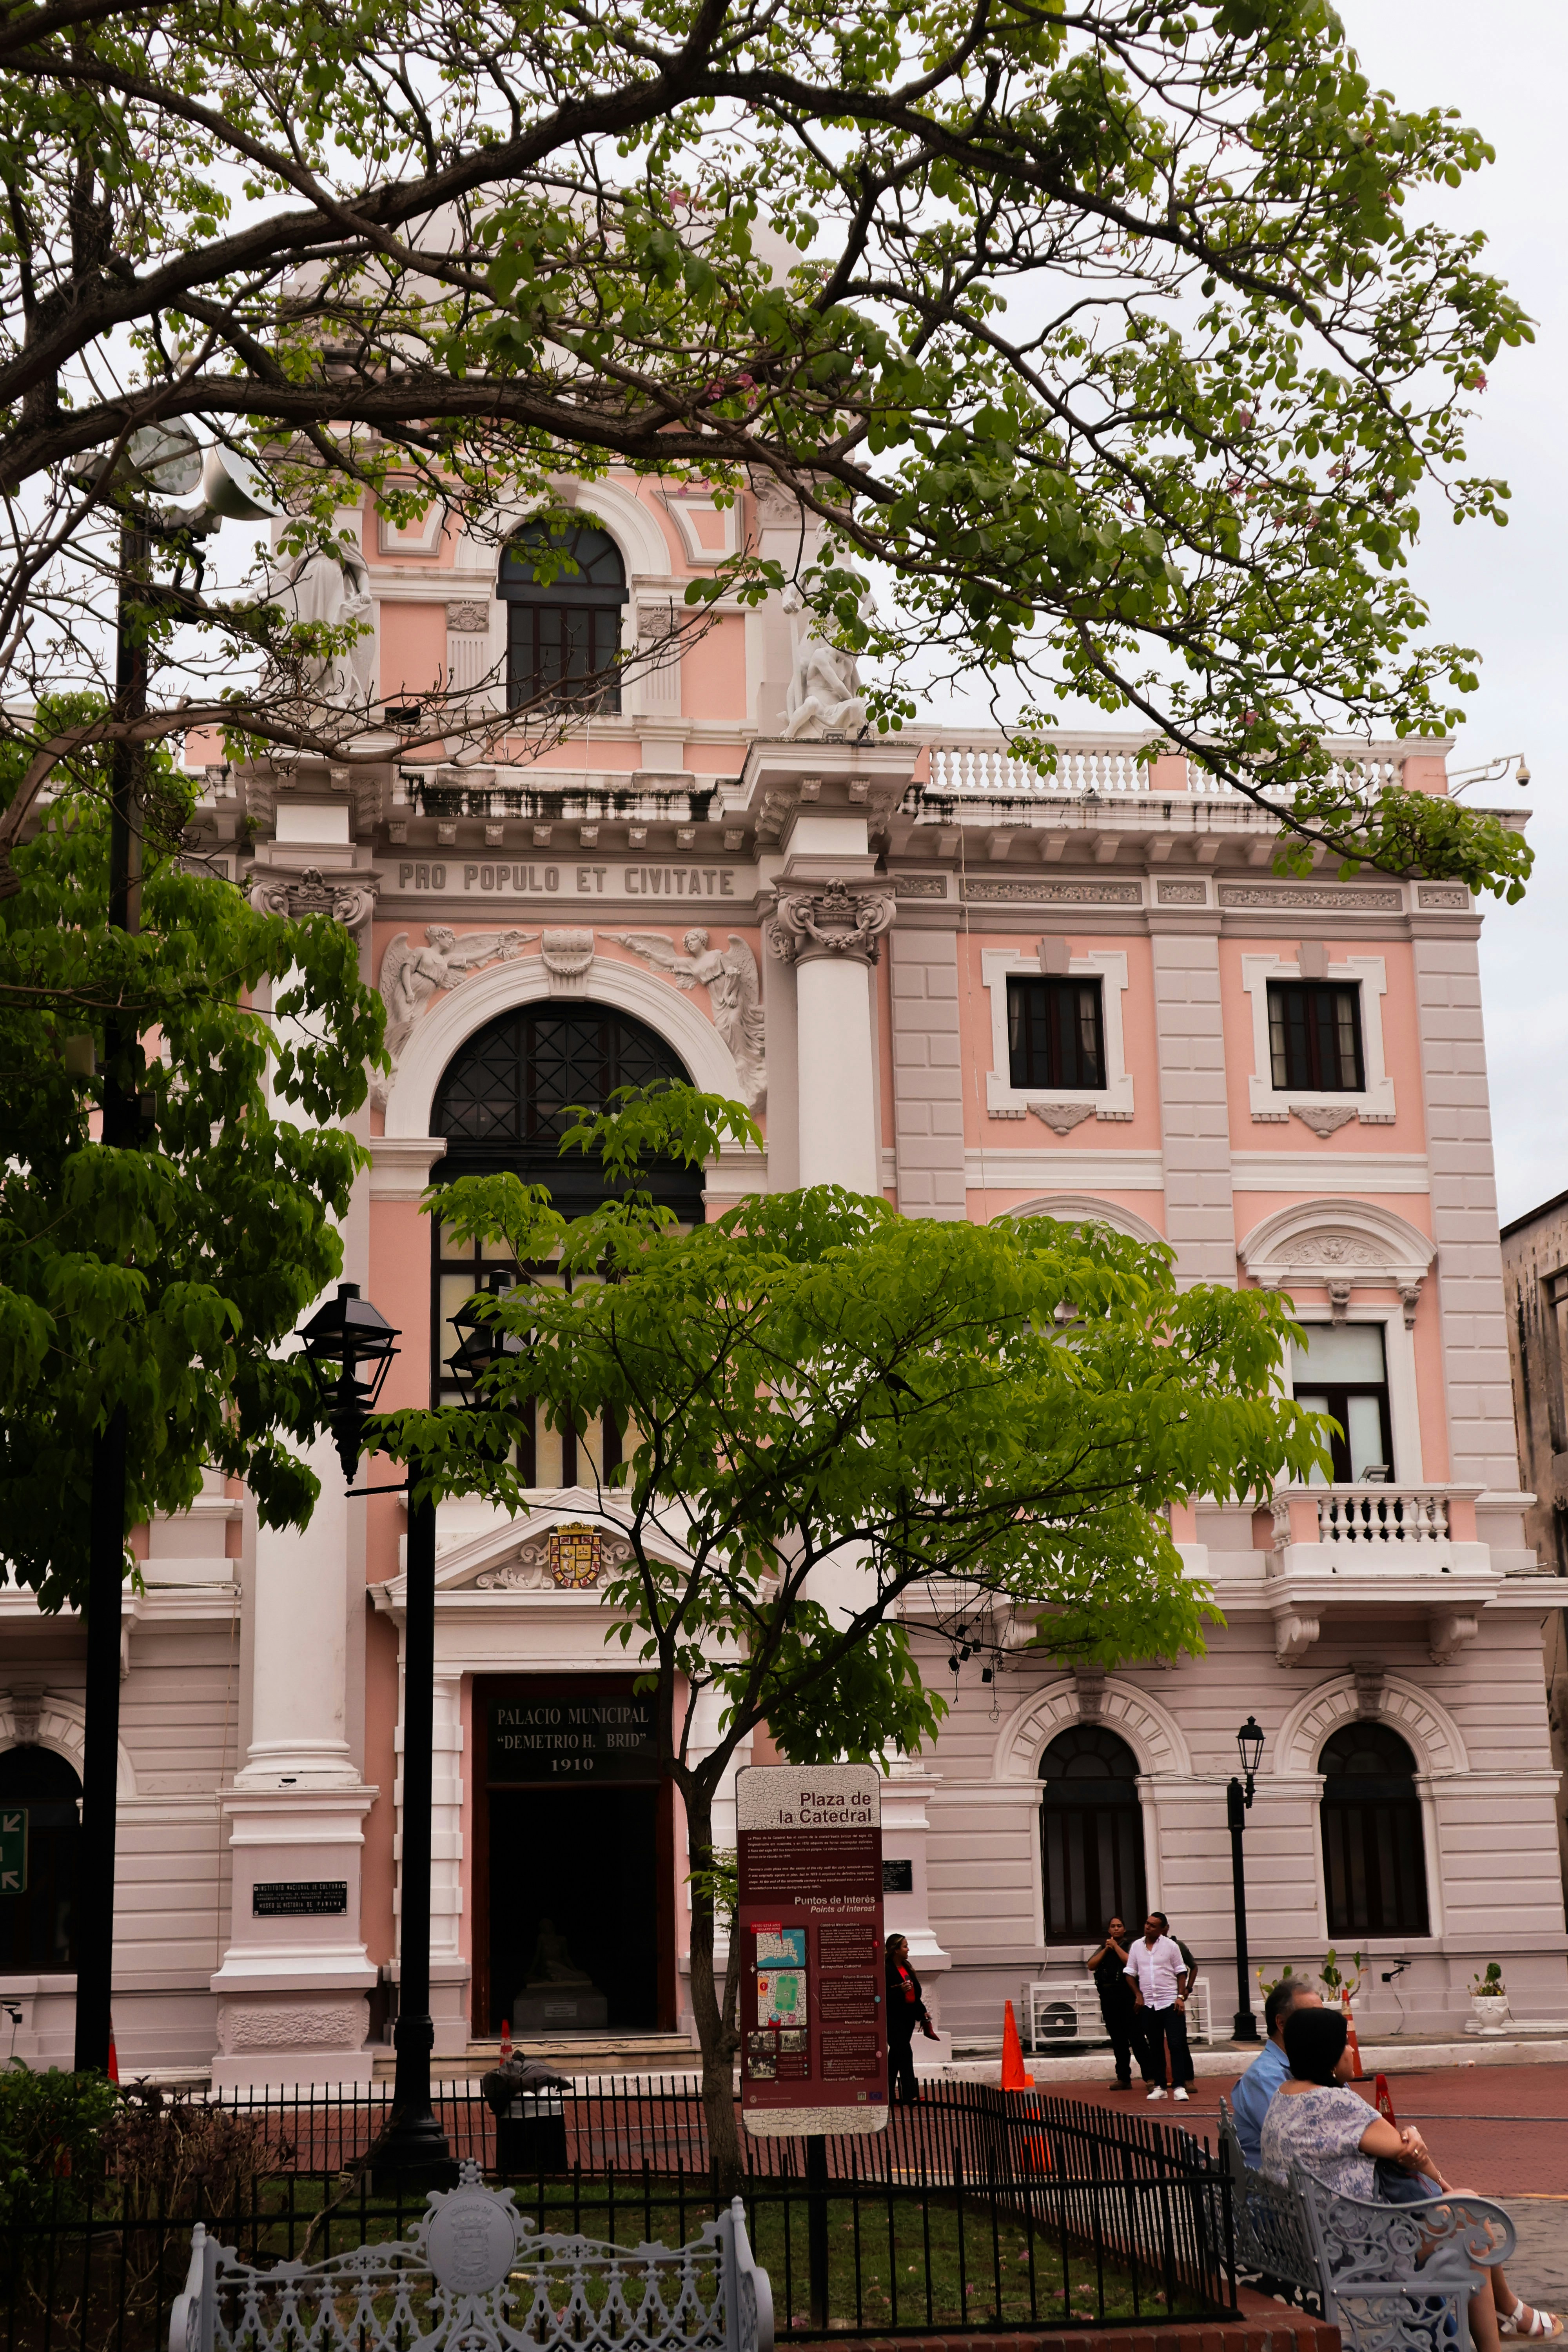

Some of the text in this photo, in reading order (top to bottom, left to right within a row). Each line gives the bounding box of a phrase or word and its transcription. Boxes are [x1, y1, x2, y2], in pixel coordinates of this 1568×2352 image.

[399, 863, 735, 895] PRO POPULO ET CIVITATE
[497, 1707, 649, 1725] PALACIO MUNICIPAL
[583, 1735, 596, 1748] H.
[551, 1759, 593, 1771] 1910
[800, 1791, 871, 1807] Plaza de
[779, 1808, 871, 1824] la Catedral
[795, 1895, 875, 1905] Puntos de Interés
[450, 2204, 493, 2216] CIUDAD DE
